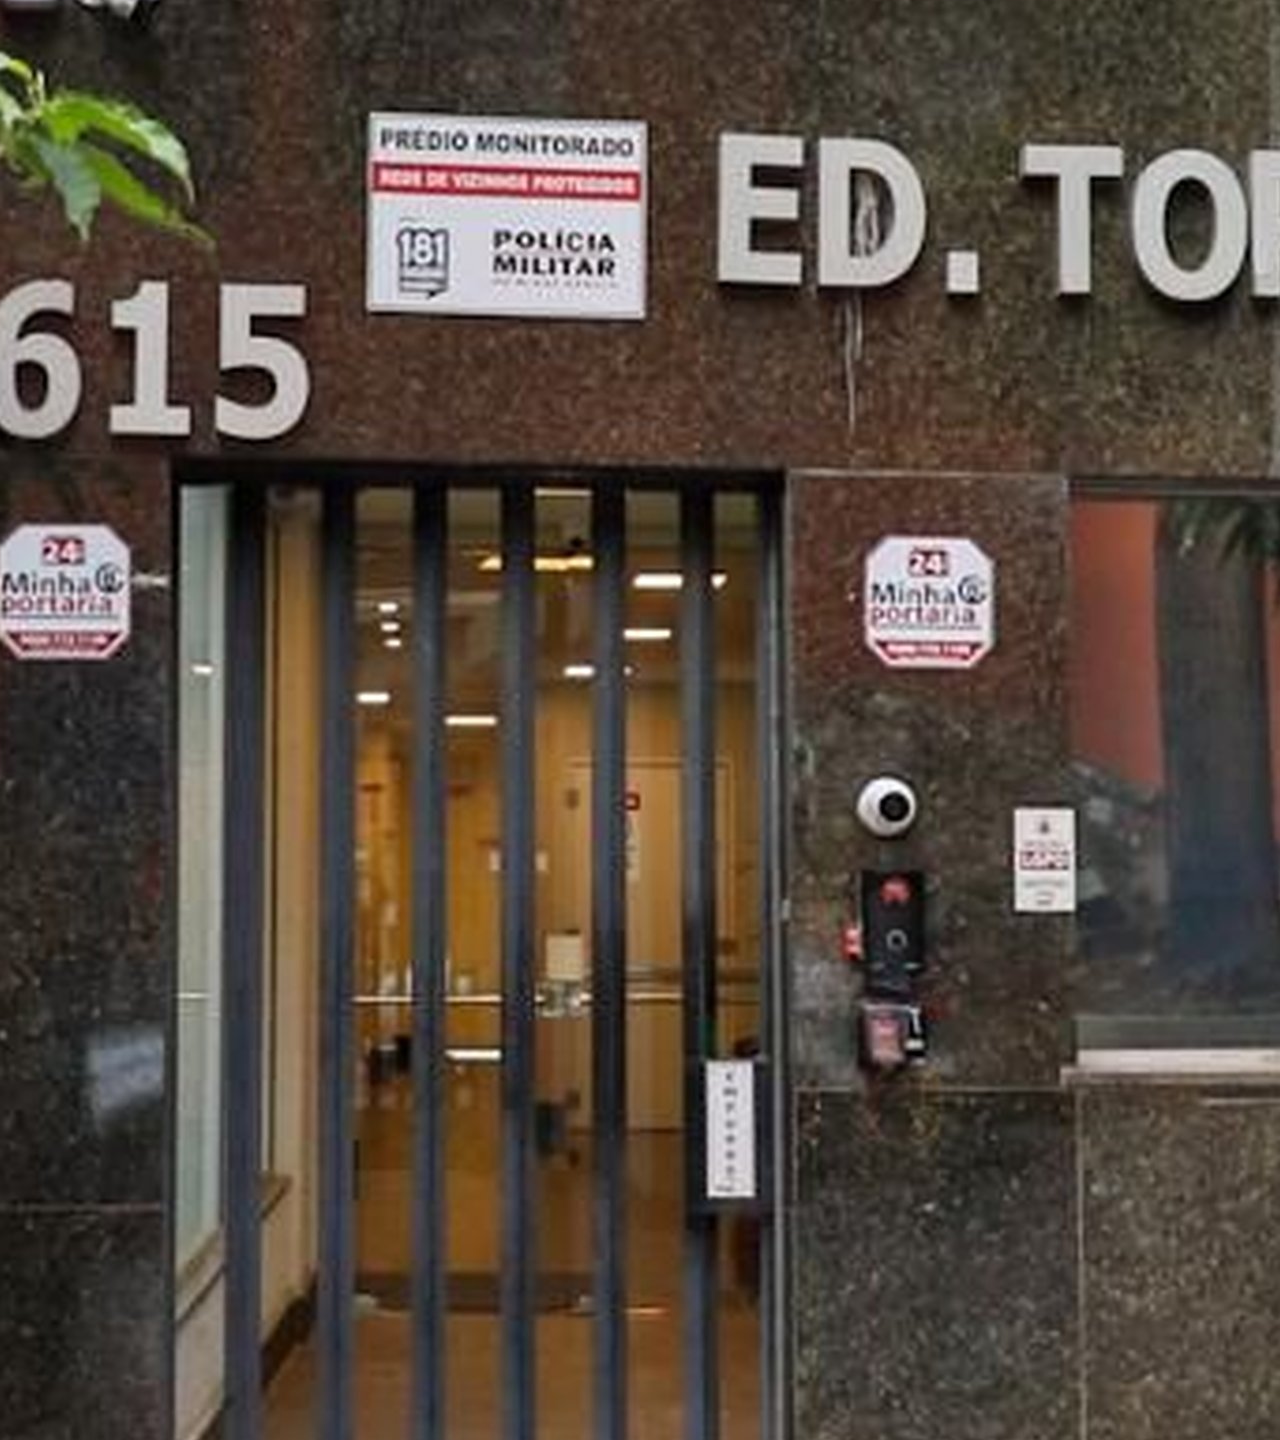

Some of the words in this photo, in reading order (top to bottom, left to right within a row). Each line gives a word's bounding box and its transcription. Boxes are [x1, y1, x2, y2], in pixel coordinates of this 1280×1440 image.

[475, 132, 635, 157] MONITORADO
[425, 169, 449, 188] DE
[717, 131, 980, 296] ED.
[398, 229, 448, 266] 181
[492, 228, 615, 253] POLÍCIA
[492, 255, 616, 277] MILITAR
[1, 571, 91, 595] Minha
[871, 581, 956, 605] Minha
[1, 596, 113, 614] portaria
[871, 606, 976, 627] portaria
